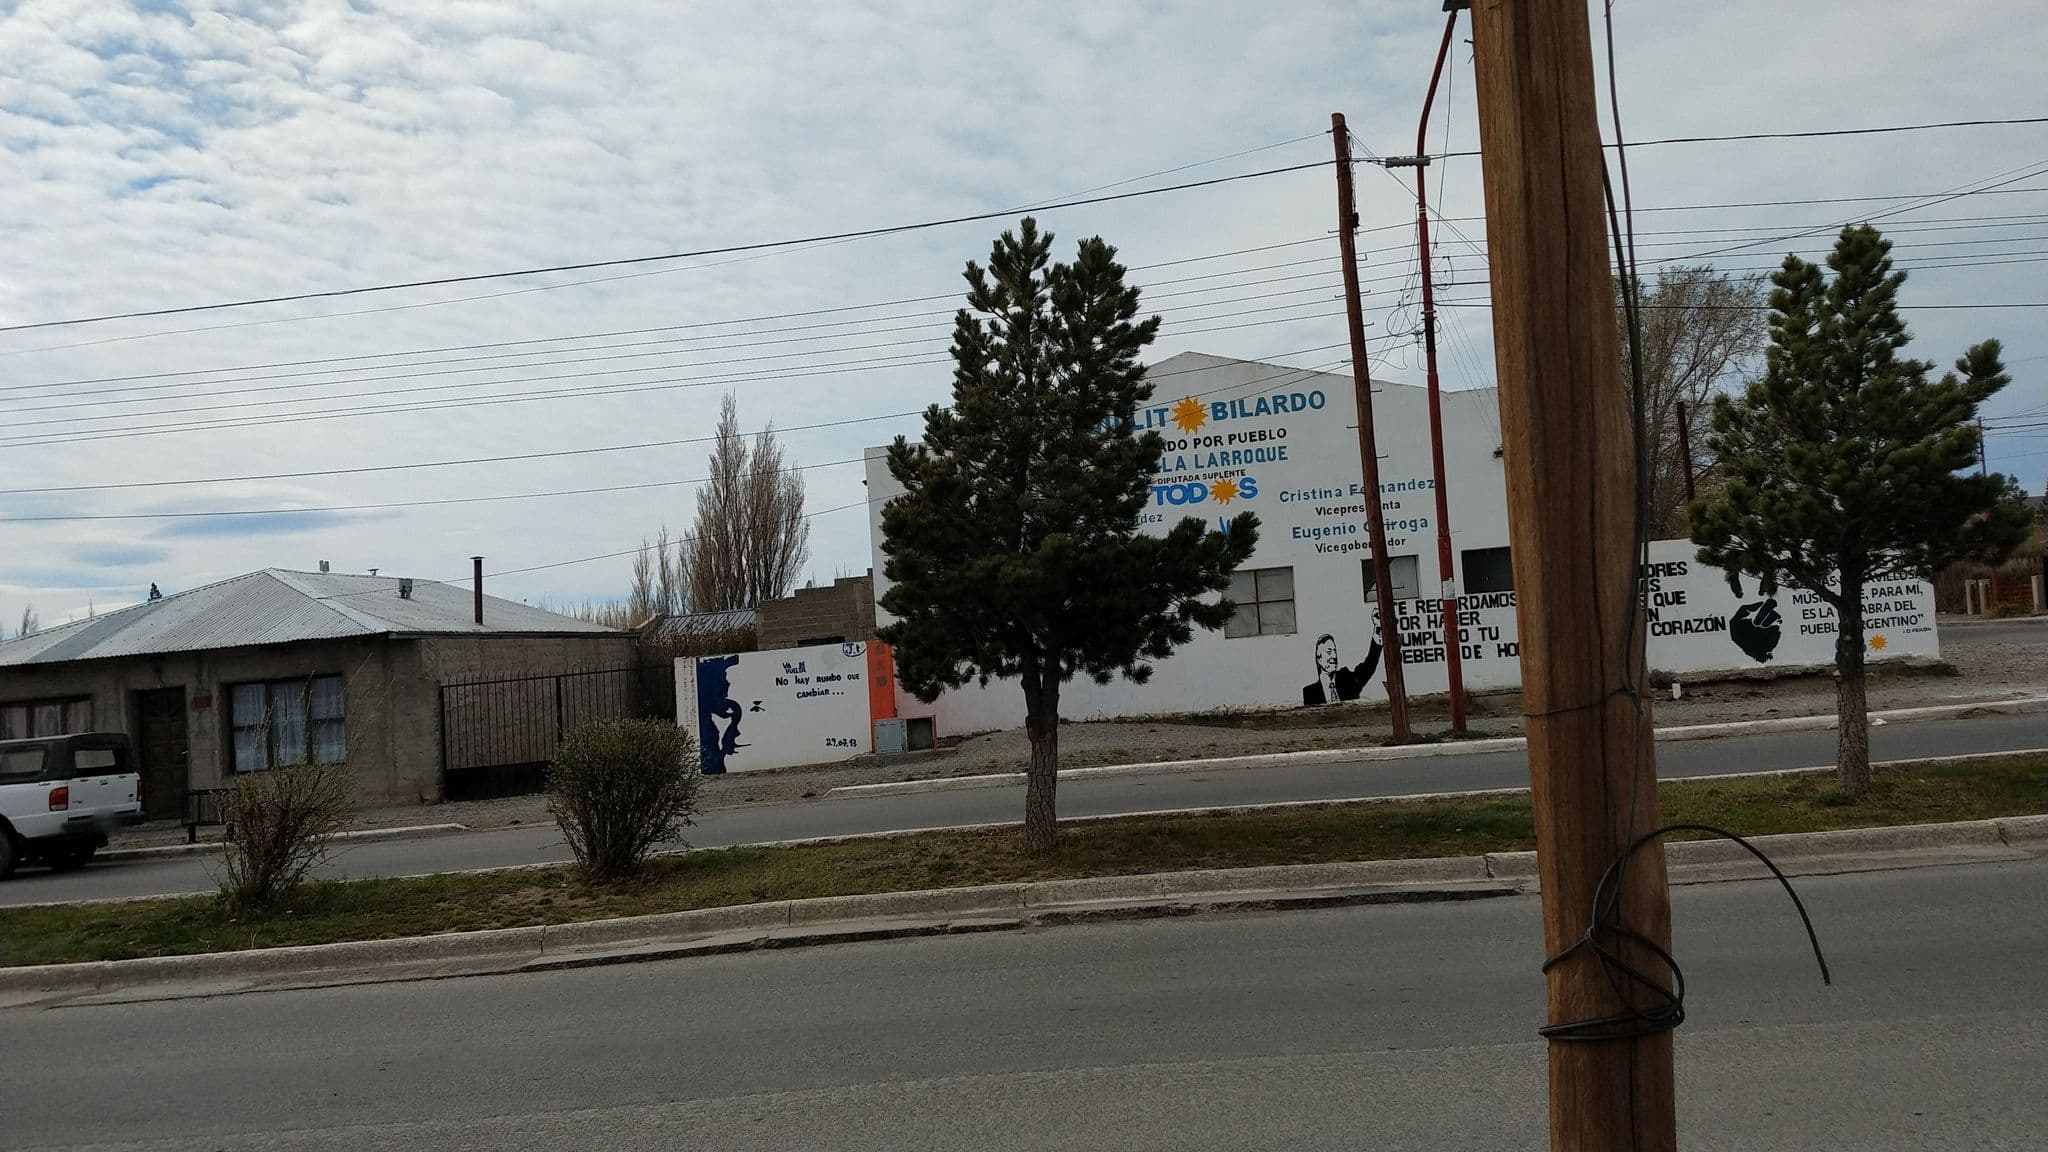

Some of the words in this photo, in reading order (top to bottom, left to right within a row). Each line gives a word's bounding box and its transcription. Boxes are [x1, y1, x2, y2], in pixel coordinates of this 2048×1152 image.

[1212, 390, 1326, 422] BILARDO
[1193, 434, 1224, 449] POR
[1228, 428, 1287, 446] PUEBLO
[1195, 445, 1288, 469] LARROQUE
[1157, 474, 1200, 485] DIPUTADA
[1202, 469, 1246, 481] SUPLENTE
[1279, 488, 1343, 503] Cristina
[1315, 500, 1401, 517] Vicepresnta
[1292, 522, 1356, 540] Eugenio
[1653, 590, 1687, 608] QUE
[1871, 585, 1904, 599] PARA
[1802, 608, 1816, 619] ES
[1820, 606, 1834, 618] LA
[1894, 599, 1917, 612] DEL
[1651, 613, 1727, 637] CORAZÓN
[1800, 622, 1840, 635] PUEBL
[1478, 626, 1499, 642] TU
[1461, 645, 1483, 660] DE
[775, 677, 789, 686] No
